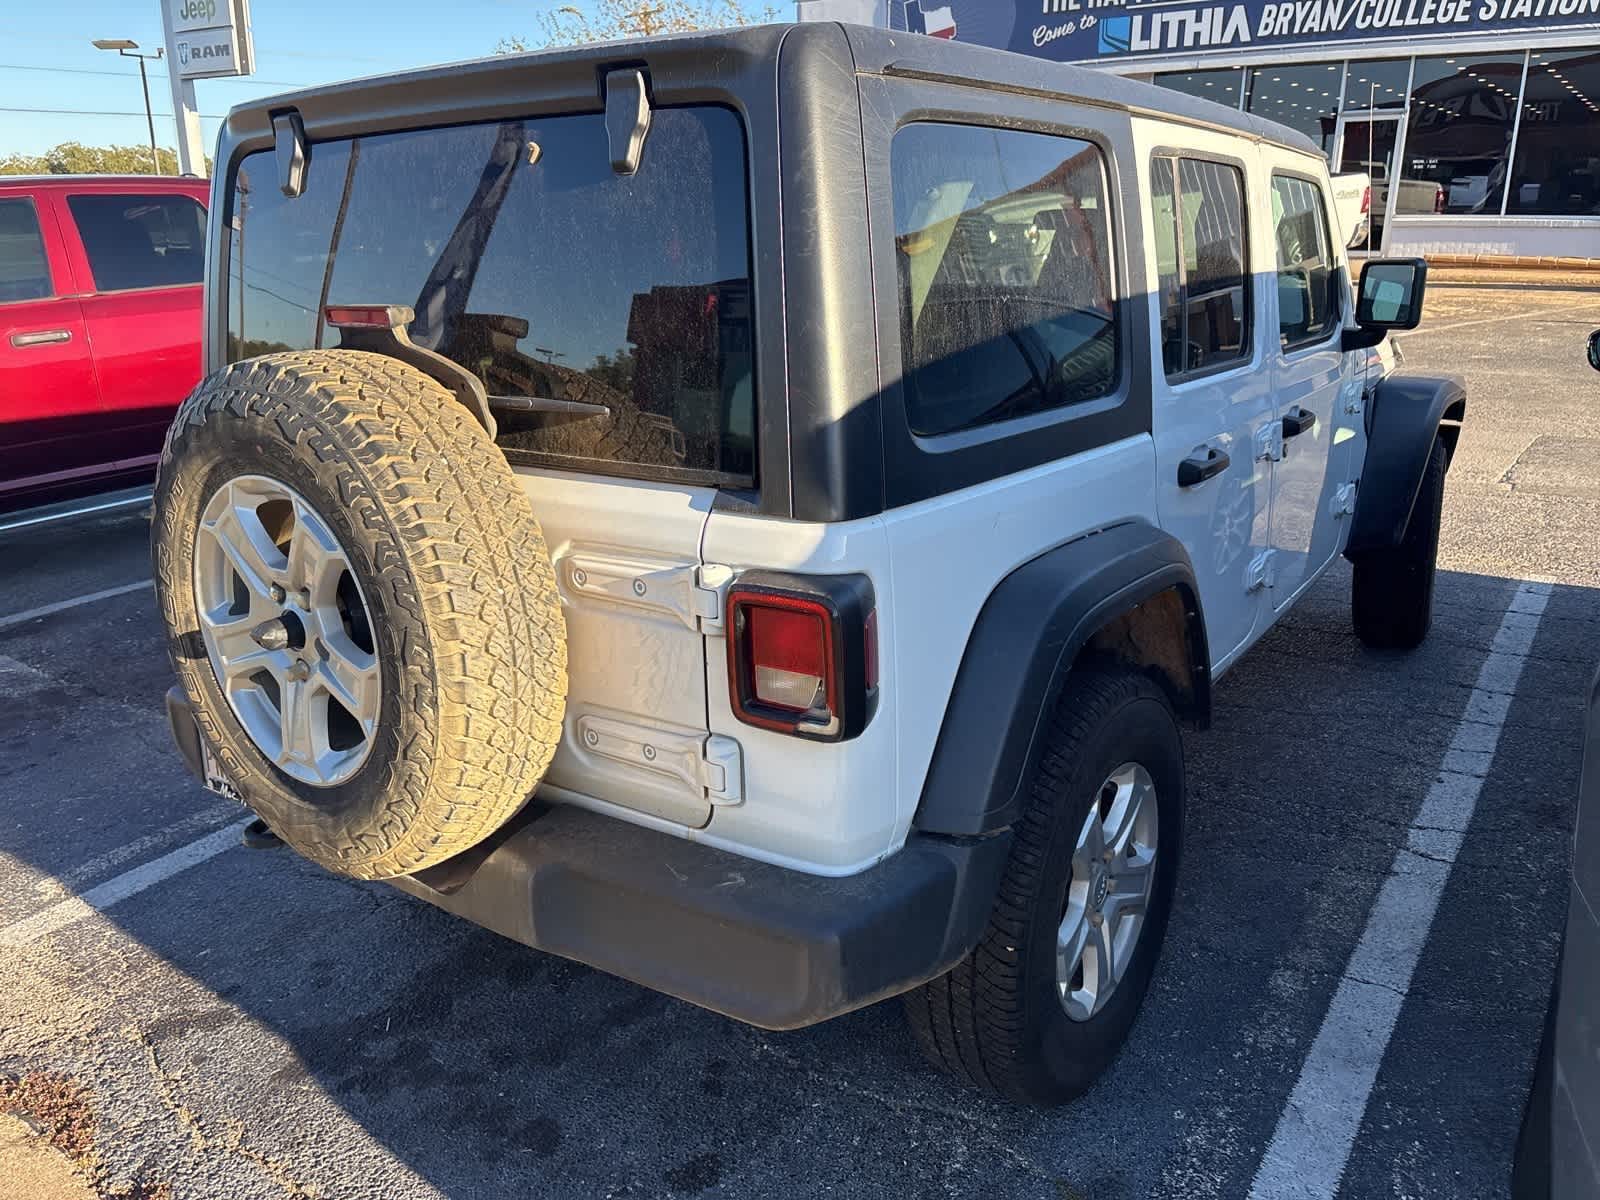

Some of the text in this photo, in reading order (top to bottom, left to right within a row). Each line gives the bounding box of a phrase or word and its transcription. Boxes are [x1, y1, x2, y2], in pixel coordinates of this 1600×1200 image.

[180, 0, 216, 22] Jeep
[1032, 14, 1098, 47] Come to
[1130, 4, 1252, 51] LITHIA
[1256, 0, 1472, 38] BRYAN/COLLEGE
[191, 44, 230, 59] RAM
